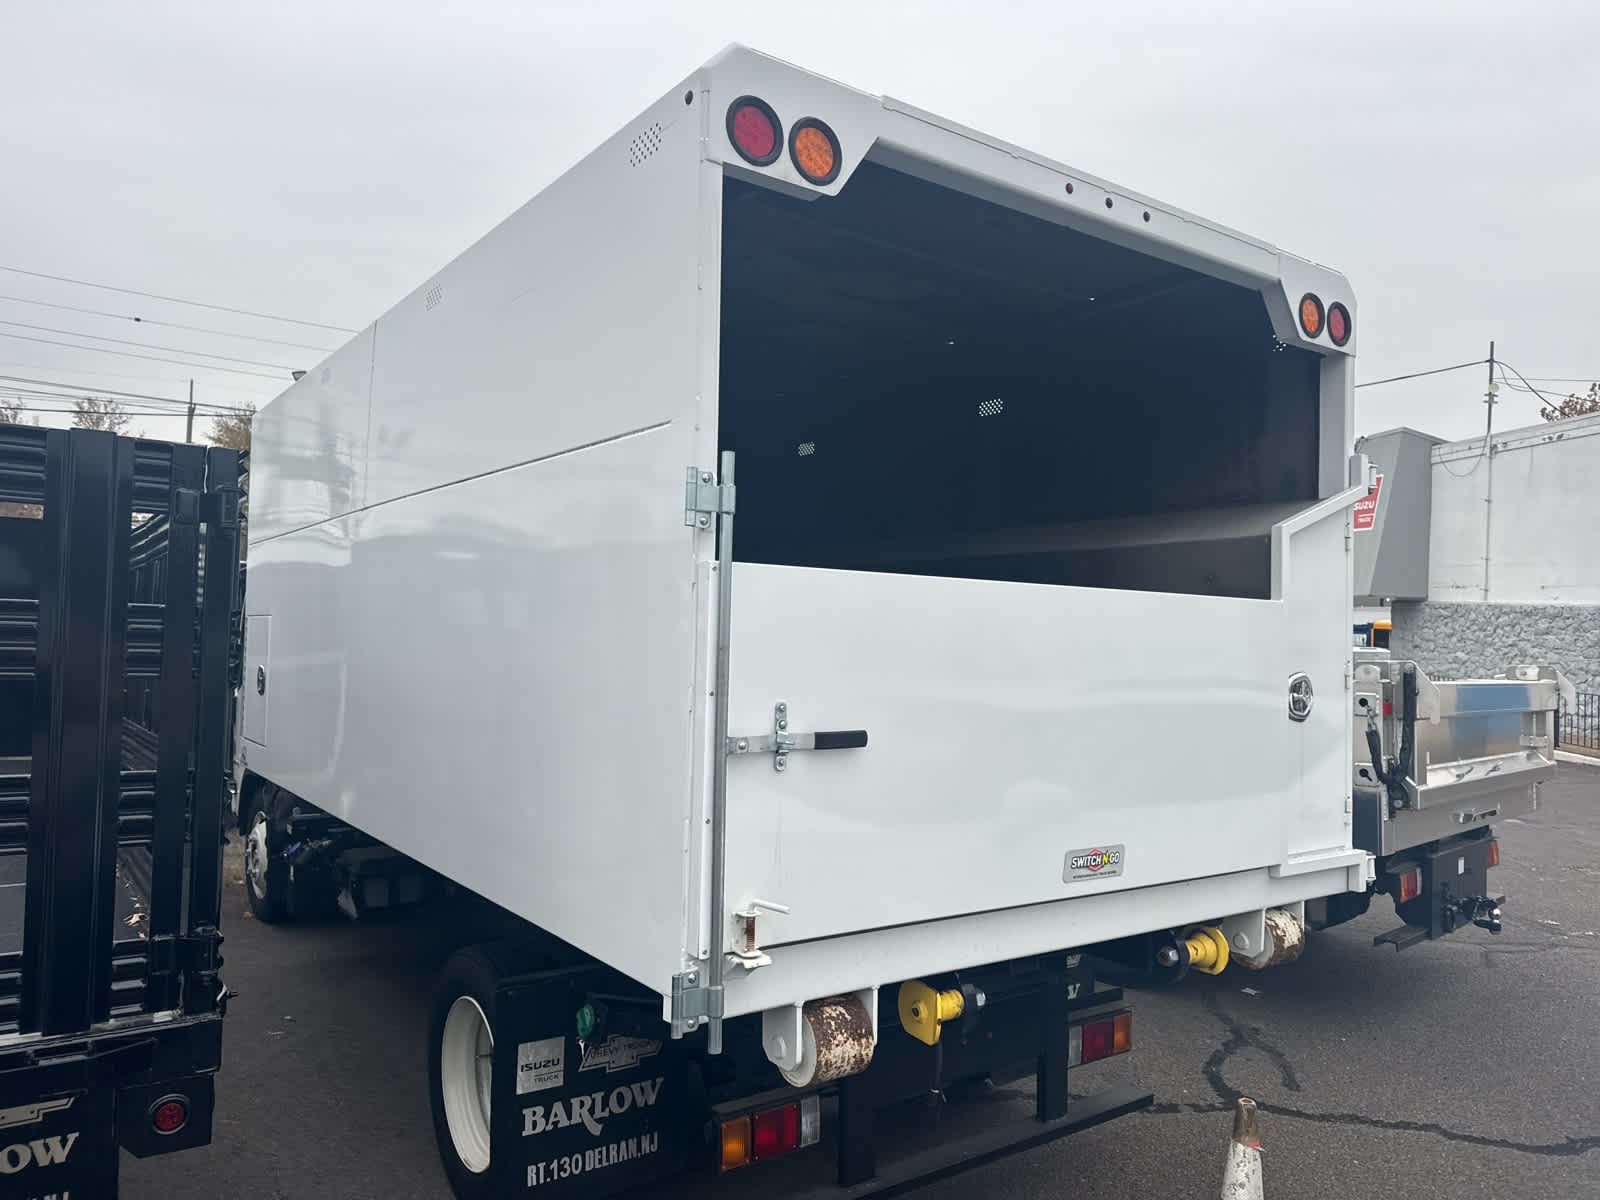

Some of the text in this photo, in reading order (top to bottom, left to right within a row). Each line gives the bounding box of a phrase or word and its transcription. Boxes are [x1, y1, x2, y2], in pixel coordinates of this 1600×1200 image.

[1072, 851, 1120, 868] SWITCH N GO
[520, 1058, 561, 1073] ISUZU
[533, 1073, 560, 1085] TRUCK
[522, 1077, 664, 1136] BARLOW
[527, 1153, 582, 1187] RT.130
